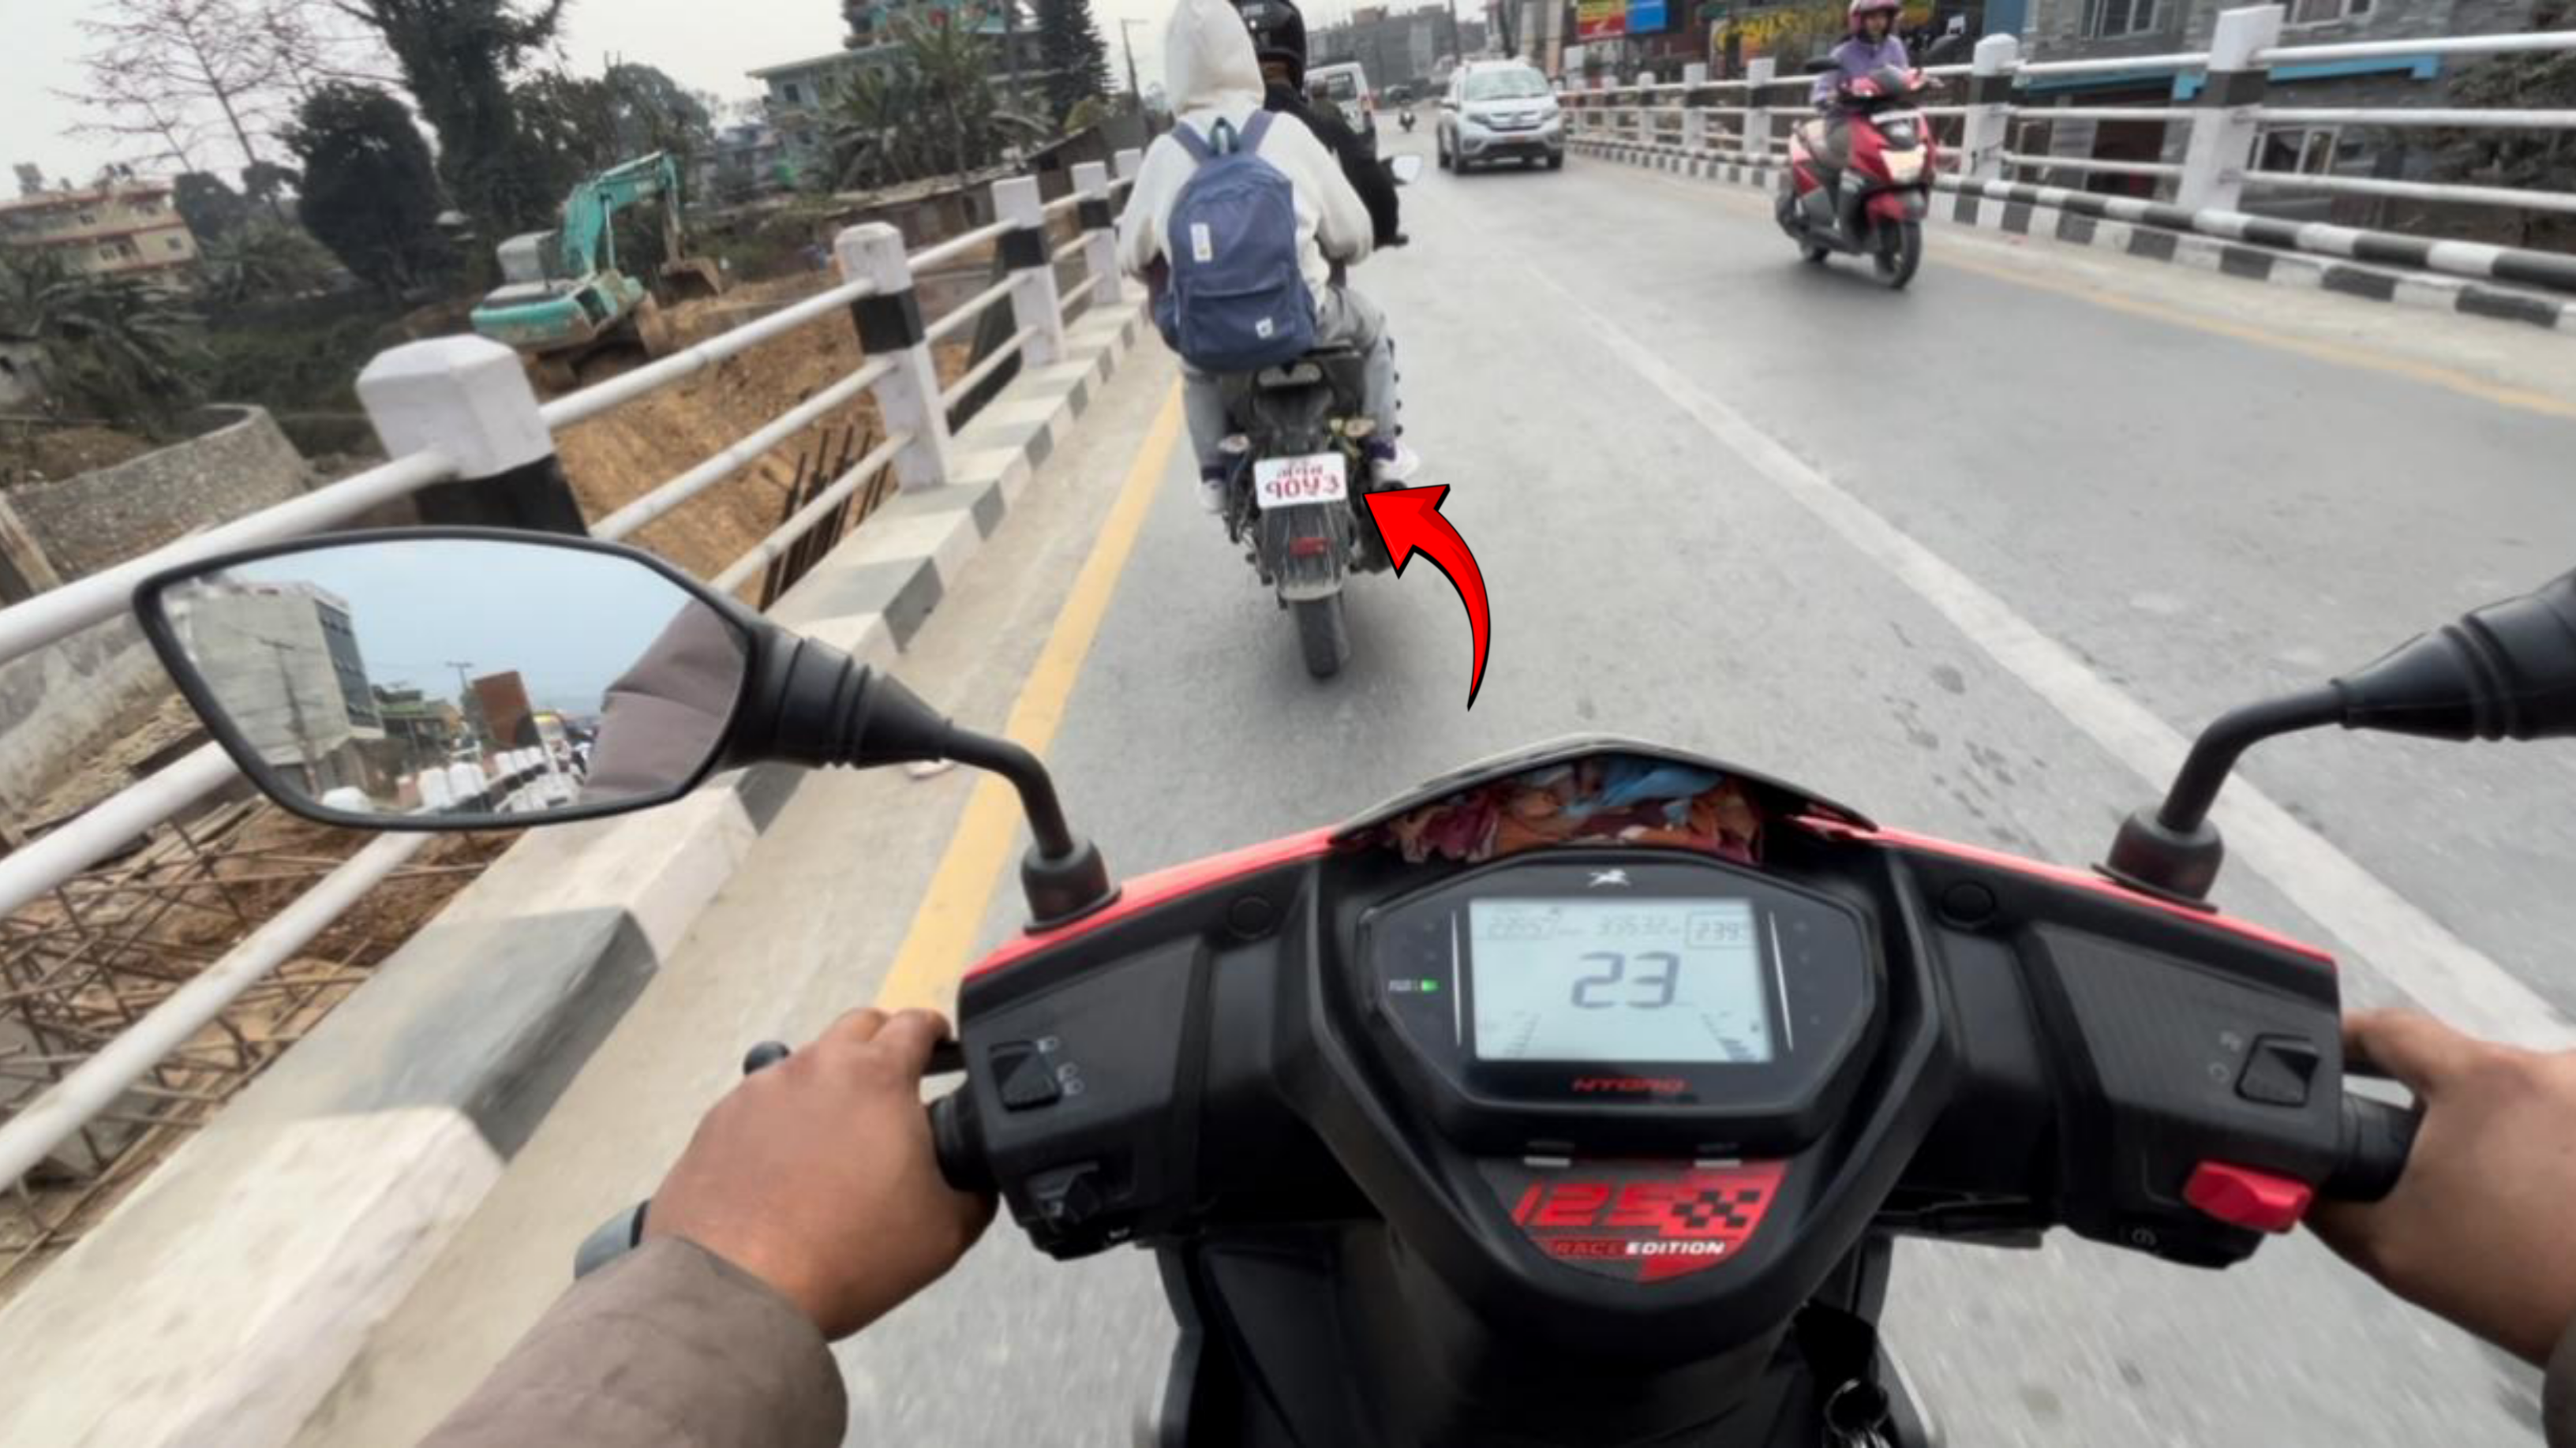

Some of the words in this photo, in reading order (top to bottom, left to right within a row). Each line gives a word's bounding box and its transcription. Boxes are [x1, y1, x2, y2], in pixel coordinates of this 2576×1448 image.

[1571, 950, 1680, 1009] 23
[1556, 1241, 1623, 1255] RACE
[1626, 1240, 1726, 1255] EDITION
